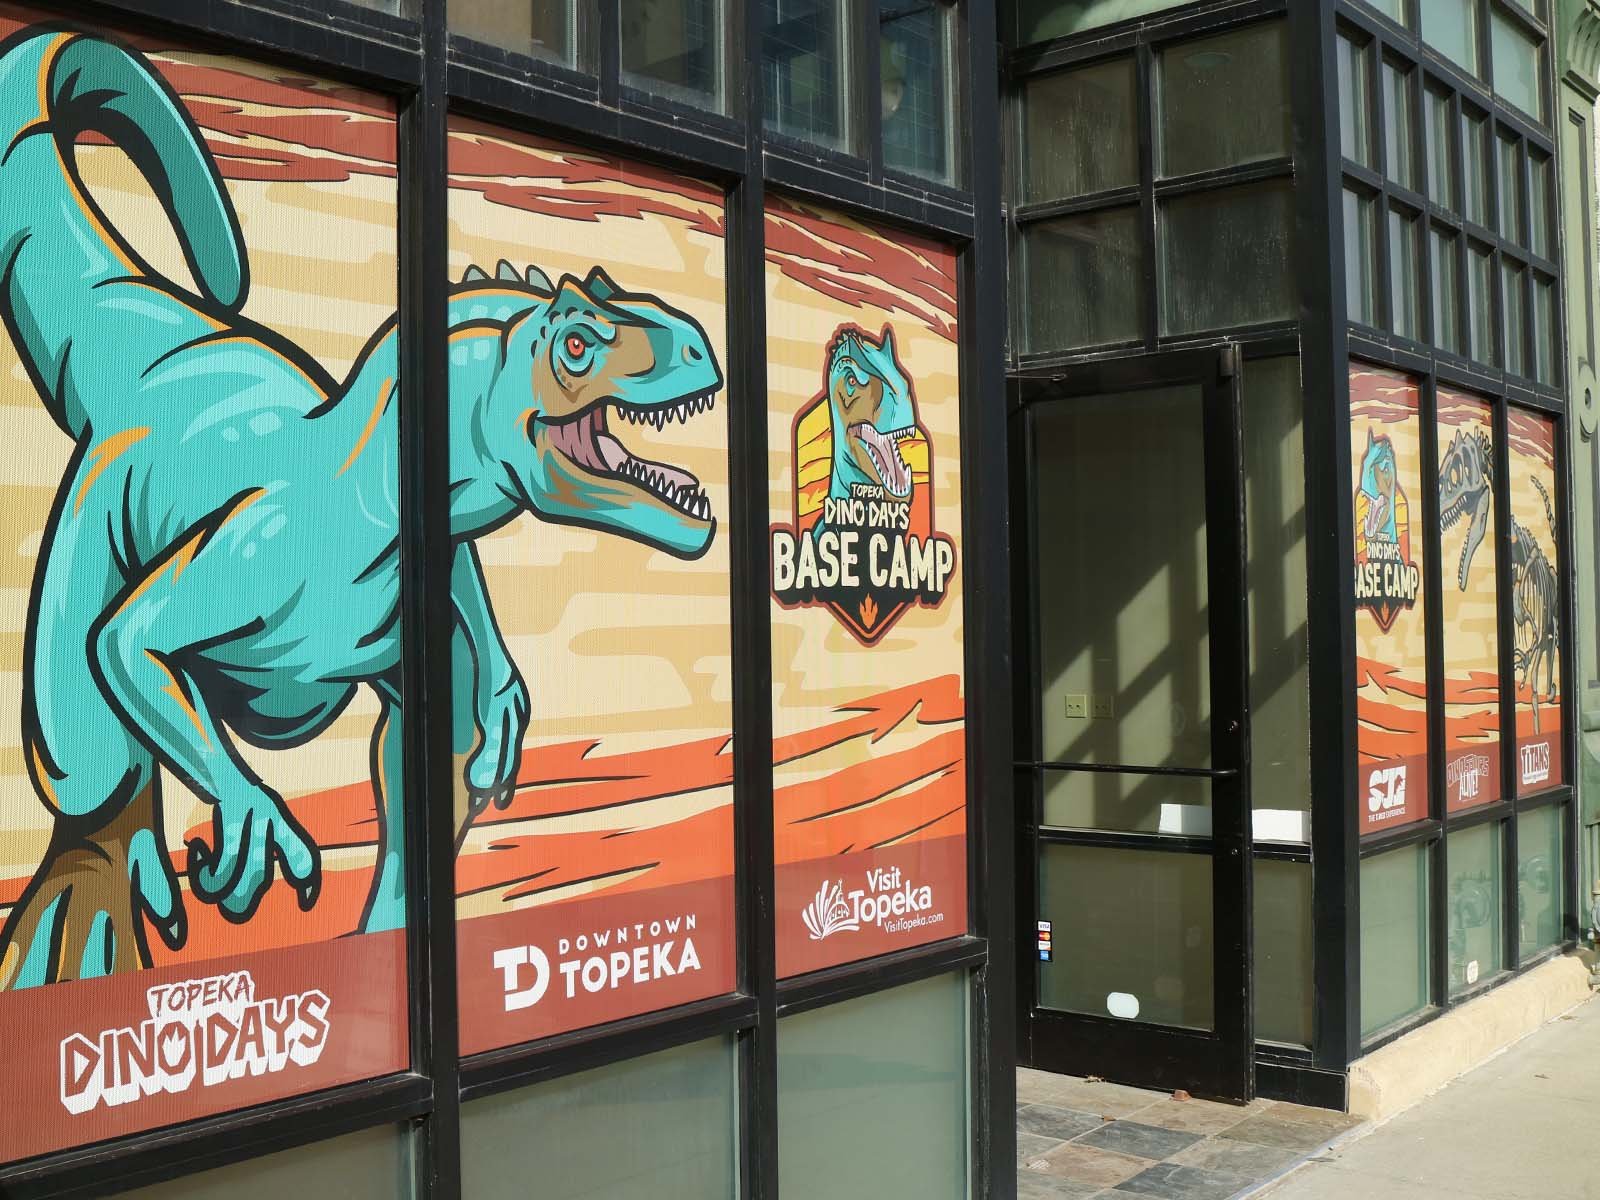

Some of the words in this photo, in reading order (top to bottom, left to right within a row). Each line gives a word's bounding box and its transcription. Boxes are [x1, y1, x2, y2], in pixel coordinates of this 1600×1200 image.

[851, 483, 884, 500] TOPEKA
[824, 498, 865, 527] DINO
[868, 500, 910, 530] DAYS
[773, 531, 860, 591] BASE
[869, 533, 953, 593] CAMP
[1366, 541, 1383, 559] DINO
[1383, 543, 1401, 560] DAYS
[1354, 563, 1382, 598] ASE
[1384, 563, 1418, 600] CAMP
[1520, 743, 1549, 776] TITANS
[866, 866, 901, 893] Visit
[848, 880, 932, 926] Topeka
[559, 914, 696, 955] DOWNTOWN
[884, 912, 944, 934] VisitTopeka.com
[559, 937, 701, 999] TOPEKA
[149, 972, 253, 1018] TOPEKA
[61, 1020, 196, 1112] DINO
[203, 990, 331, 1085] DAYS
